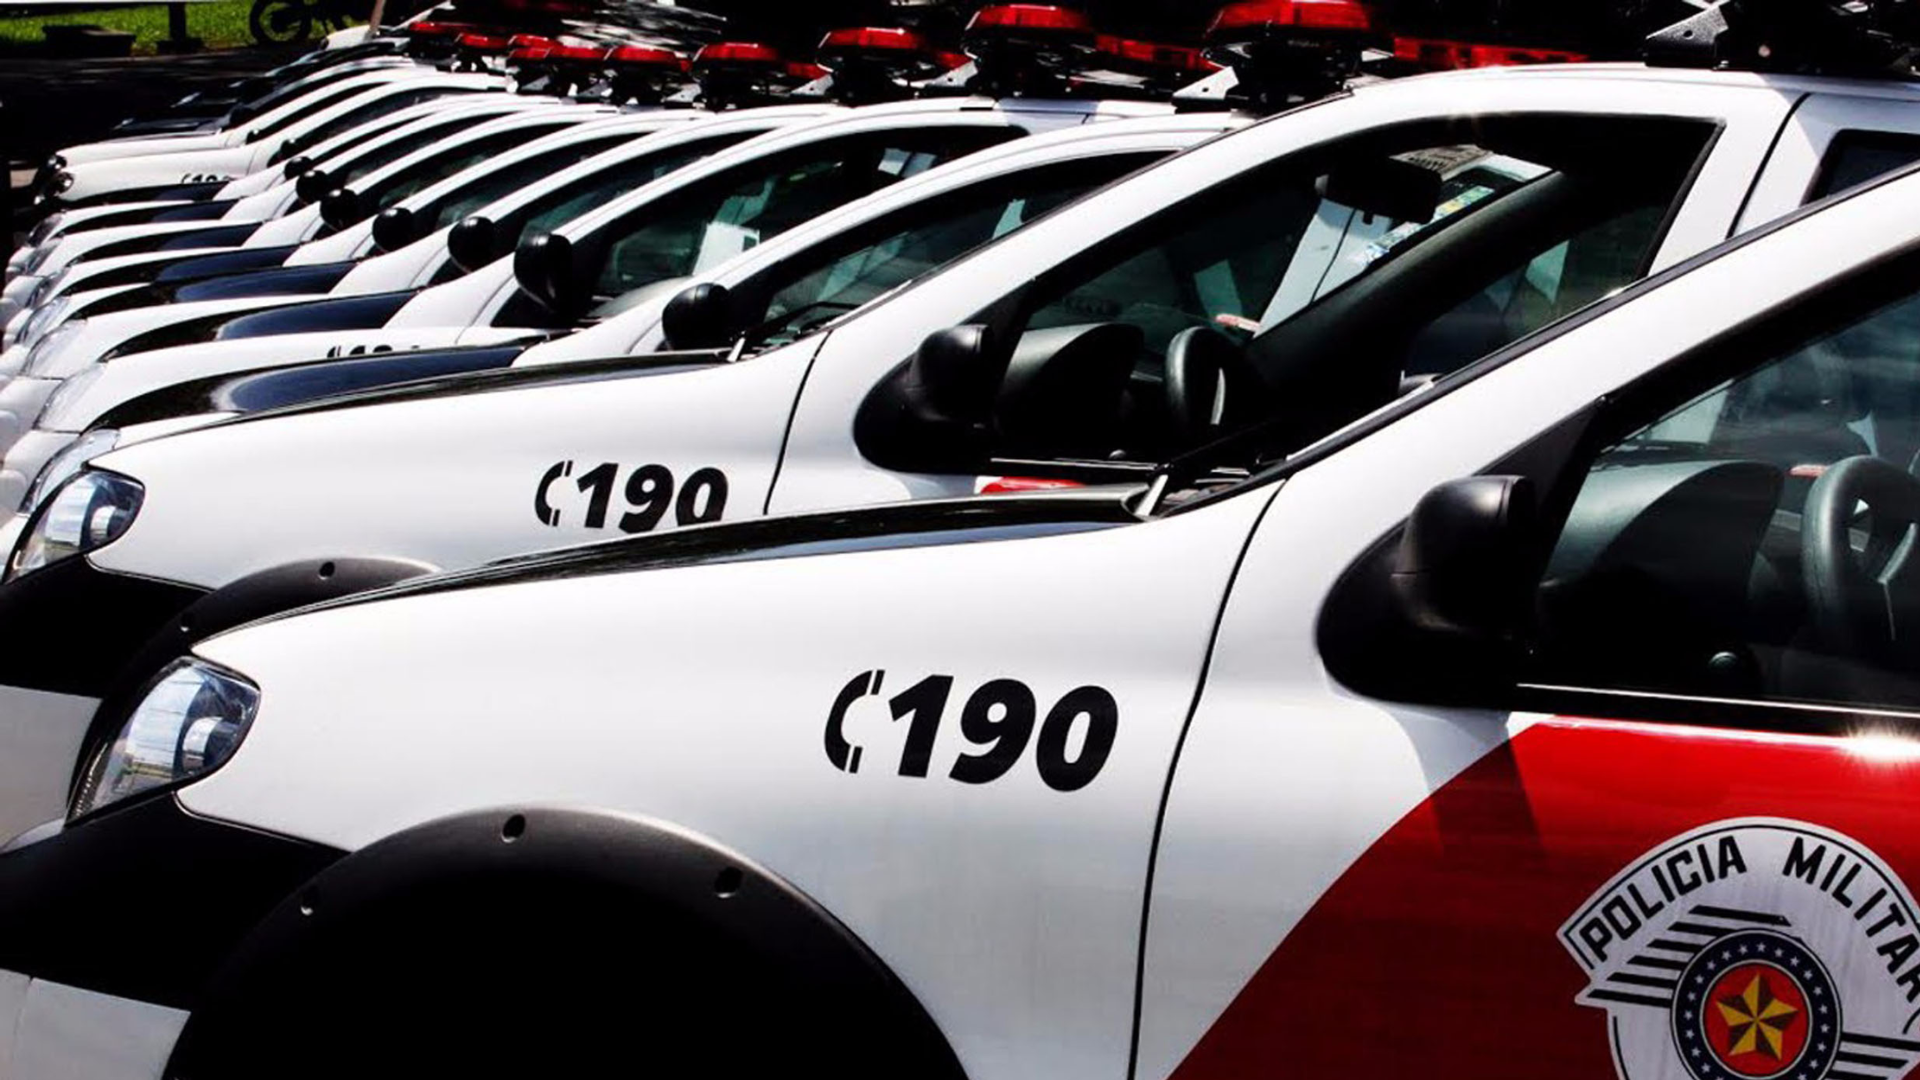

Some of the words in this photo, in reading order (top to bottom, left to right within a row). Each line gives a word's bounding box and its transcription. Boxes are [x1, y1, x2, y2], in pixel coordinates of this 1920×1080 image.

[576, 462, 729, 534] 190
[888, 674, 1118, 792] 190
[1579, 836, 1746, 962] POLICIA
